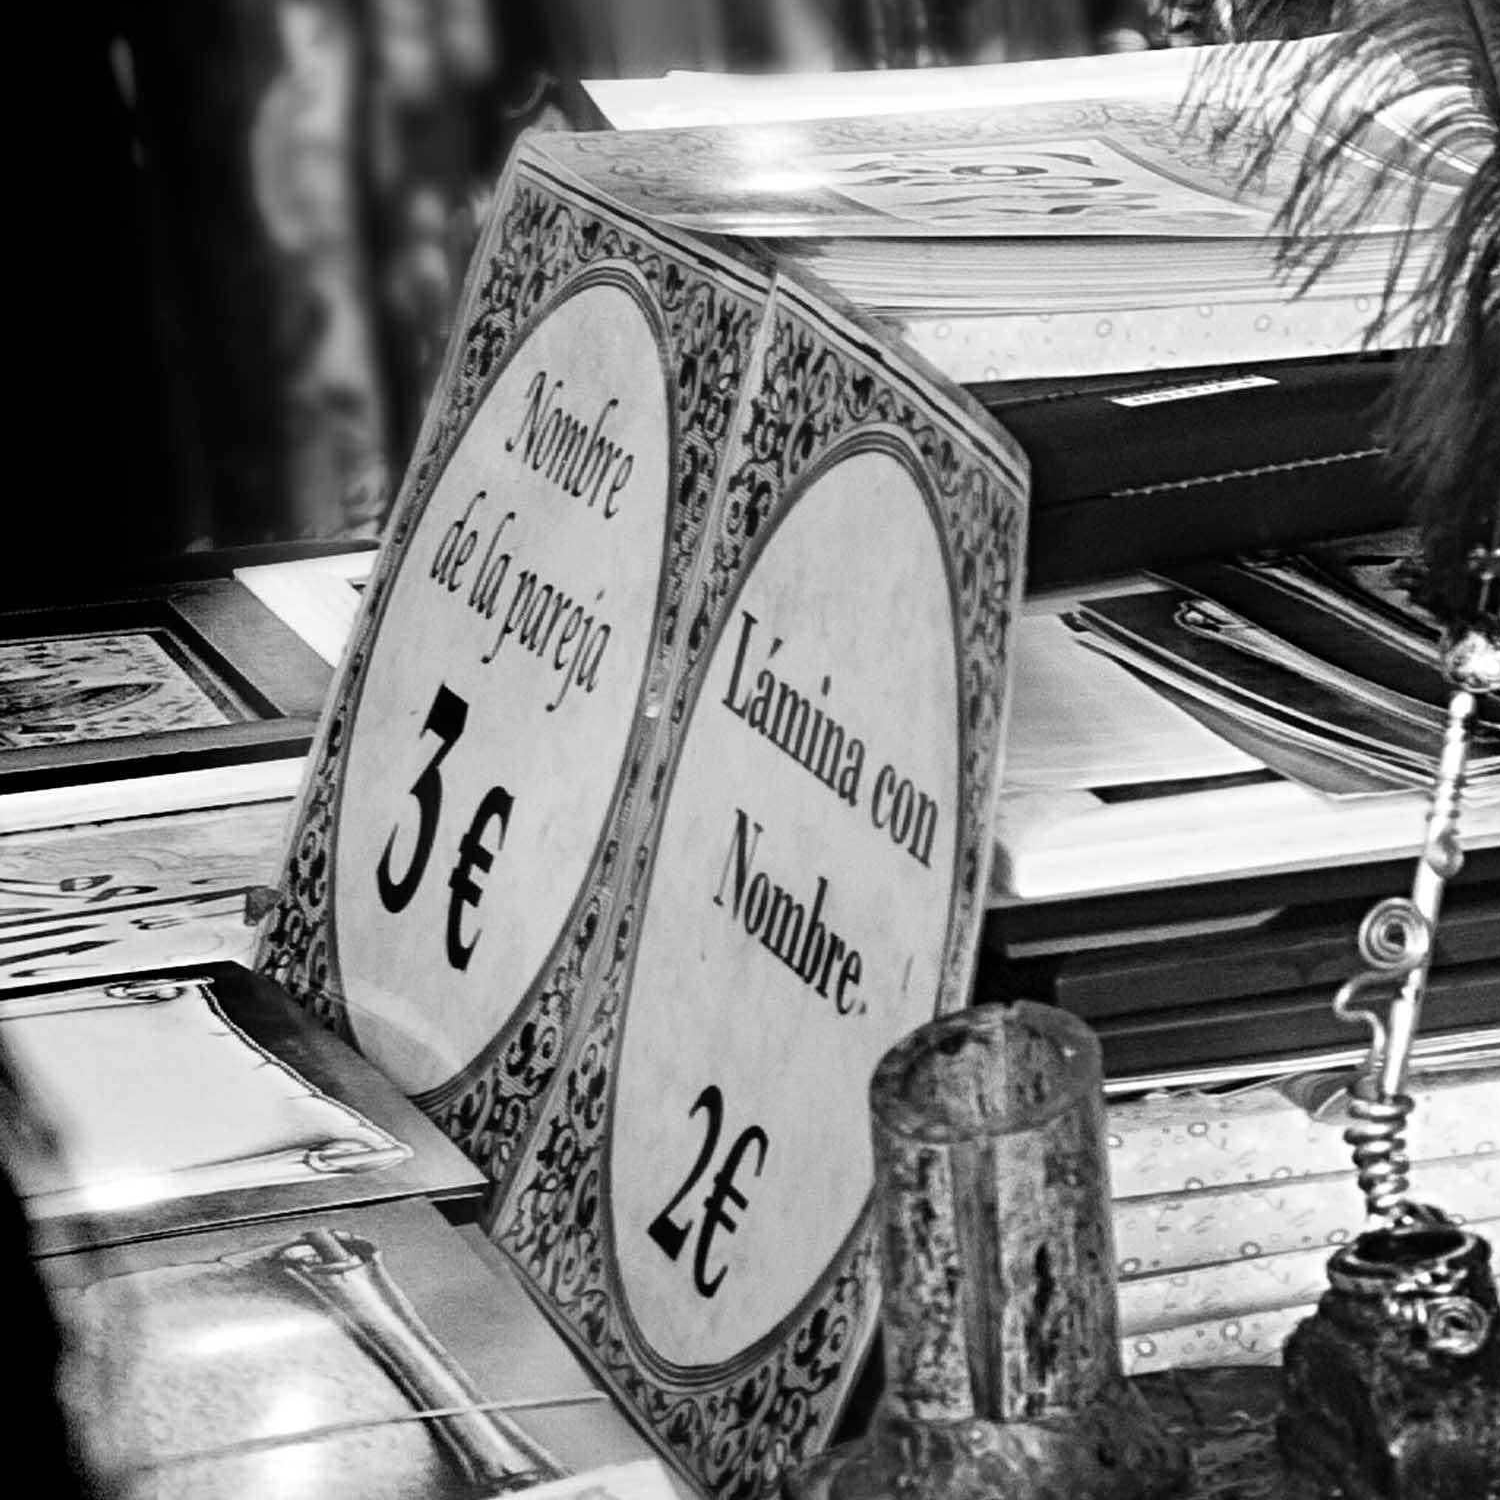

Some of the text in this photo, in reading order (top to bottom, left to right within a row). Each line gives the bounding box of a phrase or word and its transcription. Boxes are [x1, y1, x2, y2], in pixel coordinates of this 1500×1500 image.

[504, 368, 635, 522] Nombre
[430, 490, 613, 713] de la pareja
[721, 610, 941, 870] Lámina con
